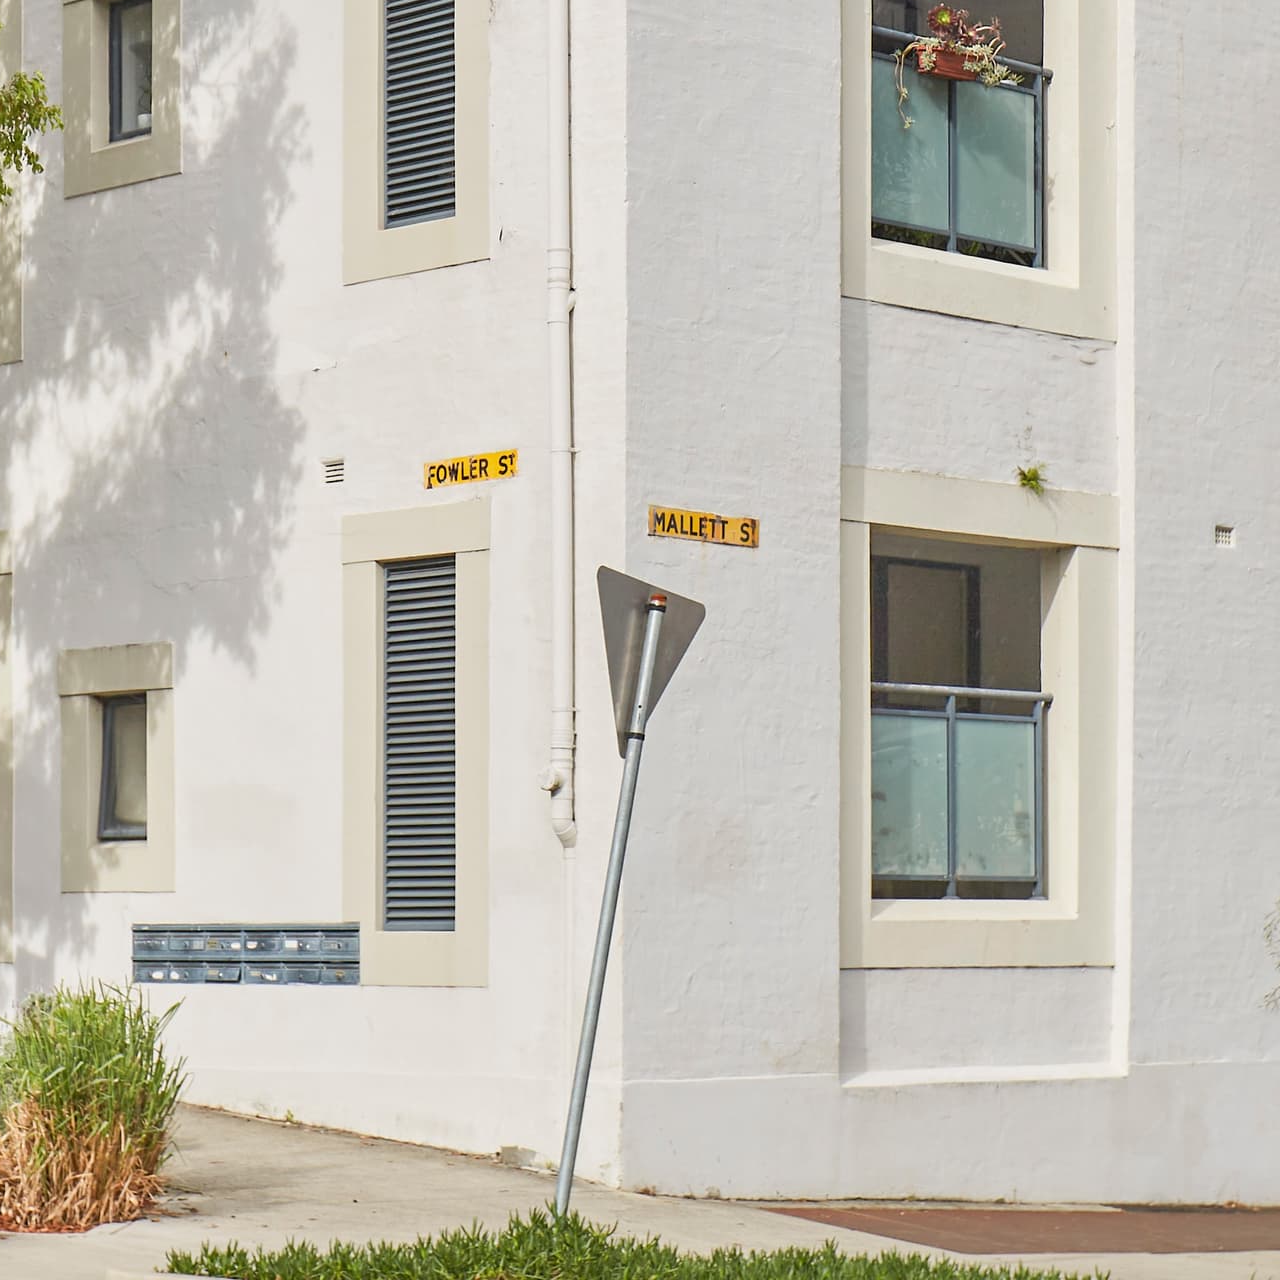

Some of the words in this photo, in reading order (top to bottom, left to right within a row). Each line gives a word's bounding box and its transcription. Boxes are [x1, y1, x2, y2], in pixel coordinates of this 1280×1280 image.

[426, 457, 489, 489] FOWLER
[498, 454, 515, 476] ST
[654, 511, 728, 540] MALLETT
